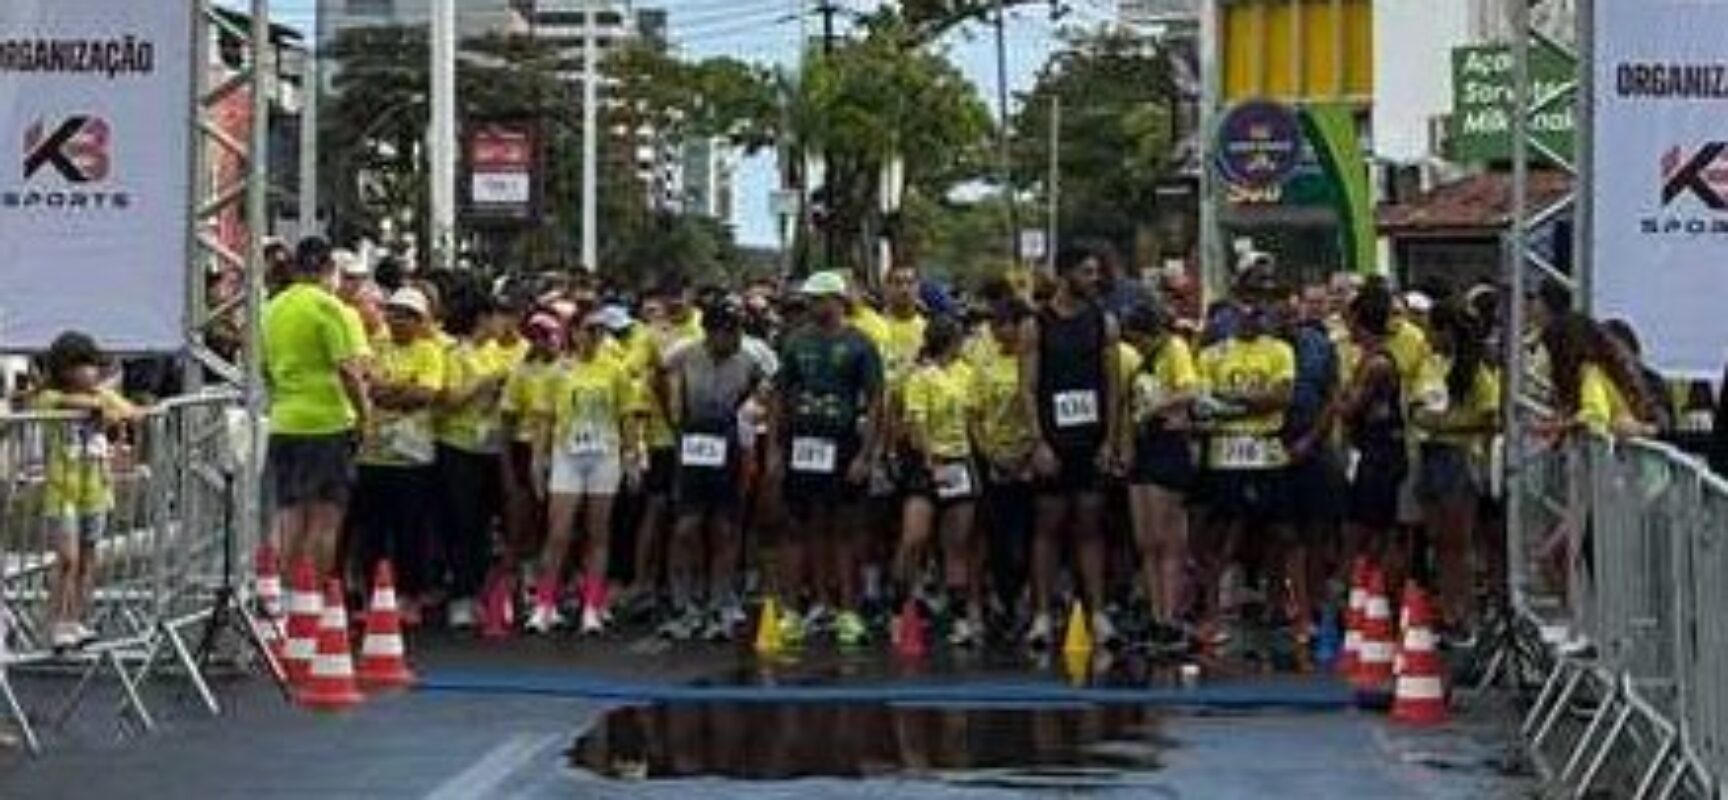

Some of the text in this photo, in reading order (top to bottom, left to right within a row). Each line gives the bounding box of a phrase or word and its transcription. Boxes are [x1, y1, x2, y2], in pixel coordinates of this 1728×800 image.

[0, 35, 154, 79] RGANIZAÇÃO
[1617, 63, 1728, 97] ORGANIZ
[3, 193, 129, 207] SPORTS
